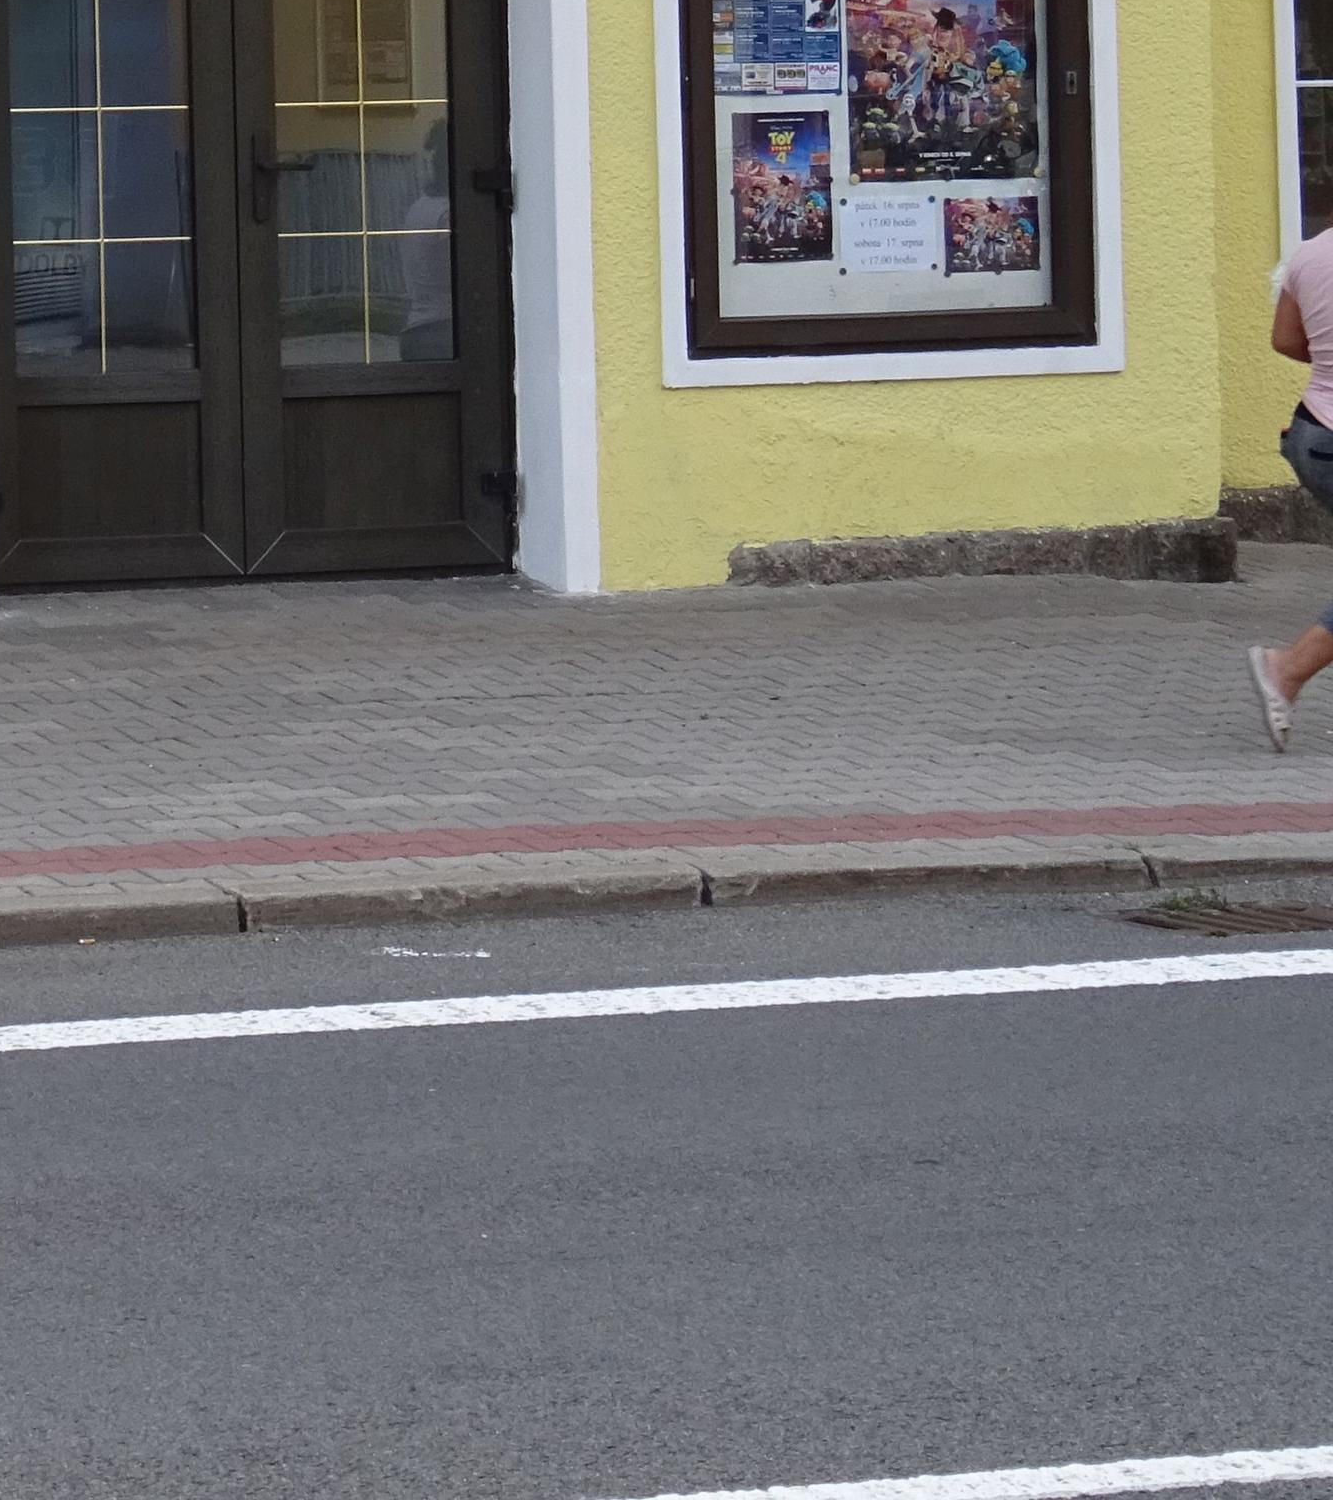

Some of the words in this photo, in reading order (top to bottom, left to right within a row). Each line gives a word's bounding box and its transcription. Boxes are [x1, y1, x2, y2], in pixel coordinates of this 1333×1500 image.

[768, 131, 795, 146] TOY
[893, 218, 916, 227] hodin
[854, 238, 881, 248] sobota
